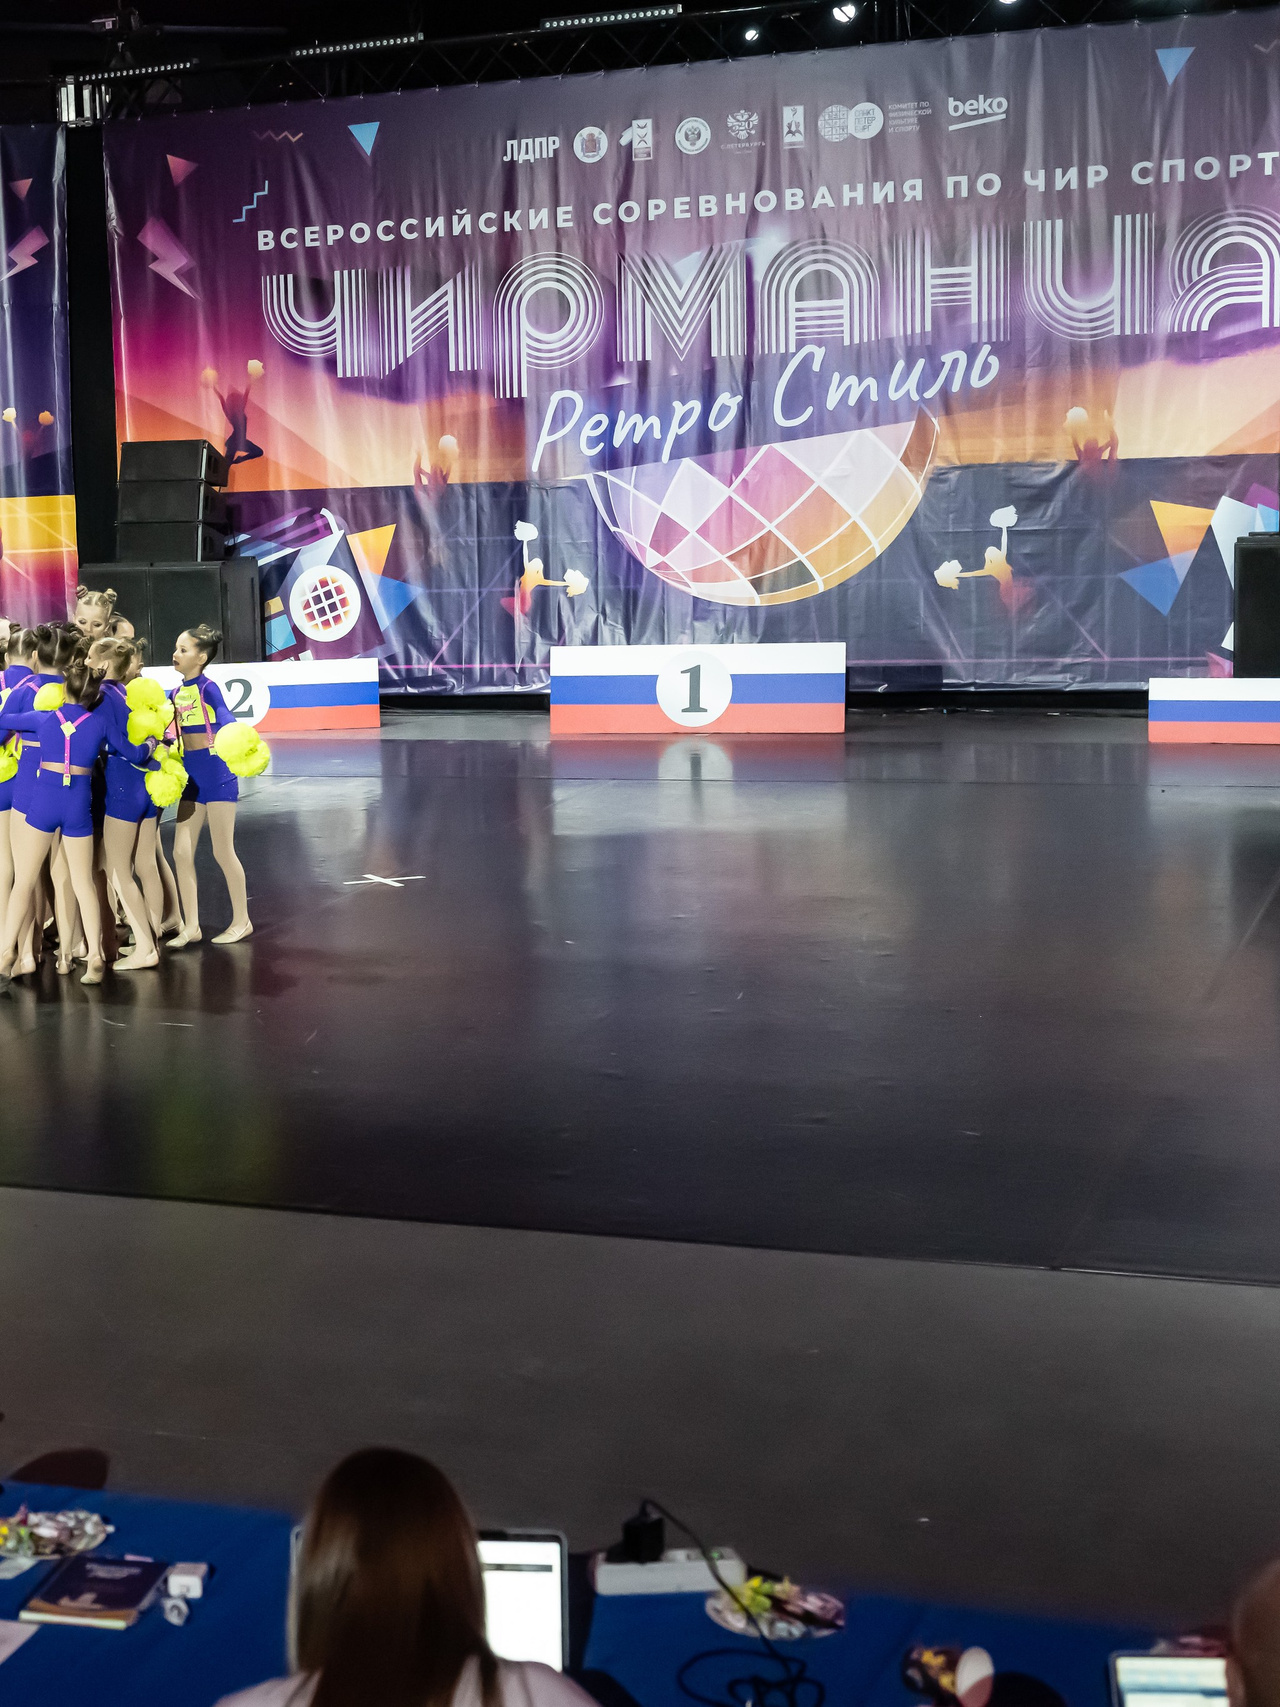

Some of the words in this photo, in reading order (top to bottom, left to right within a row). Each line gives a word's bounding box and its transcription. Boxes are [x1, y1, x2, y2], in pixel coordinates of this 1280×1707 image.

[948, 94, 1008, 118] beko
[503, 136, 560, 164] ЛДПР
[258, 205, 575, 251] ВСЕРОССИЙСКИЕ
[593, 178, 924, 225] СОРЕВНОВАНИЯ
[946, 172, 1003, 200] ПО
[1023, 164, 1109, 192] ЧИР
[531, 389, 743, 473] Ретро
[773, 344, 1000, 427] Стиль
[224, 678, 254, 718] 2
[679, 663, 709, 714] 1
